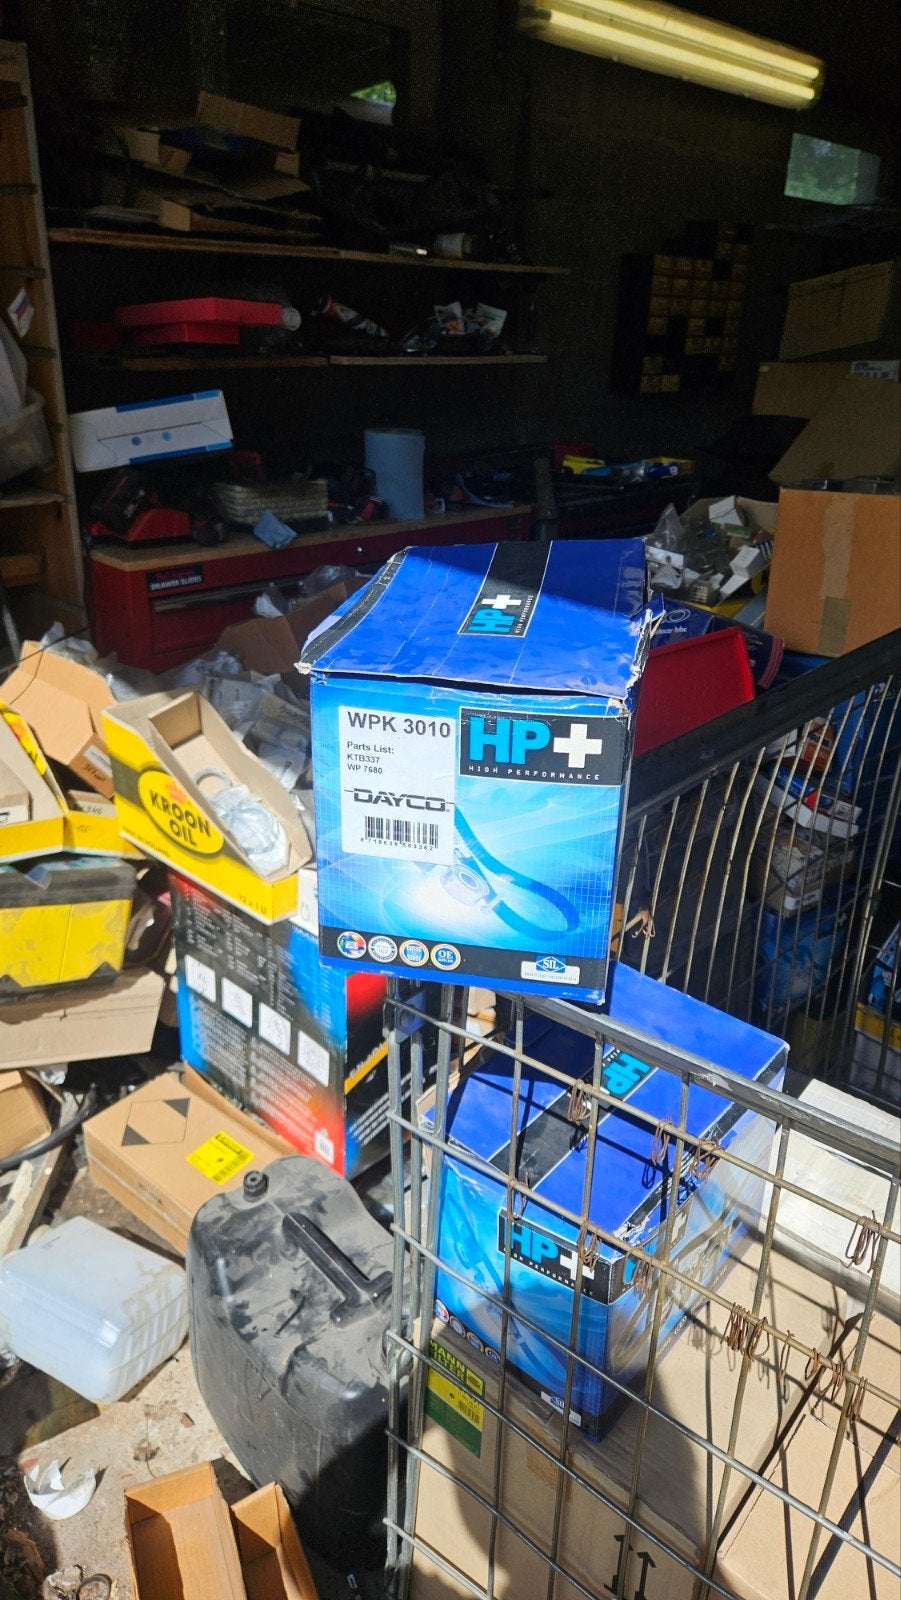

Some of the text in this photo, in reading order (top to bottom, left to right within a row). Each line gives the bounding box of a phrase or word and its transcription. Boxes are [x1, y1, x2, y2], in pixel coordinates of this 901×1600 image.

[347, 711, 451, 738] WPK 3010
[347, 741, 395, 754] Parts List:
[347, 753, 380, 764] KTB337
[347, 764, 383, 774] WP 7680
[469, 765, 600, 781] HIGH PERFORMANCE
[354, 788, 446, 812] DAYCO
[150, 790, 211, 837] KROON
[169, 819, 197, 847] OIL
[543, 959, 559, 970] SIL
[529, 1261, 594, 1296] PERFORMACE
[434, 1350, 465, 1381] ILTER
